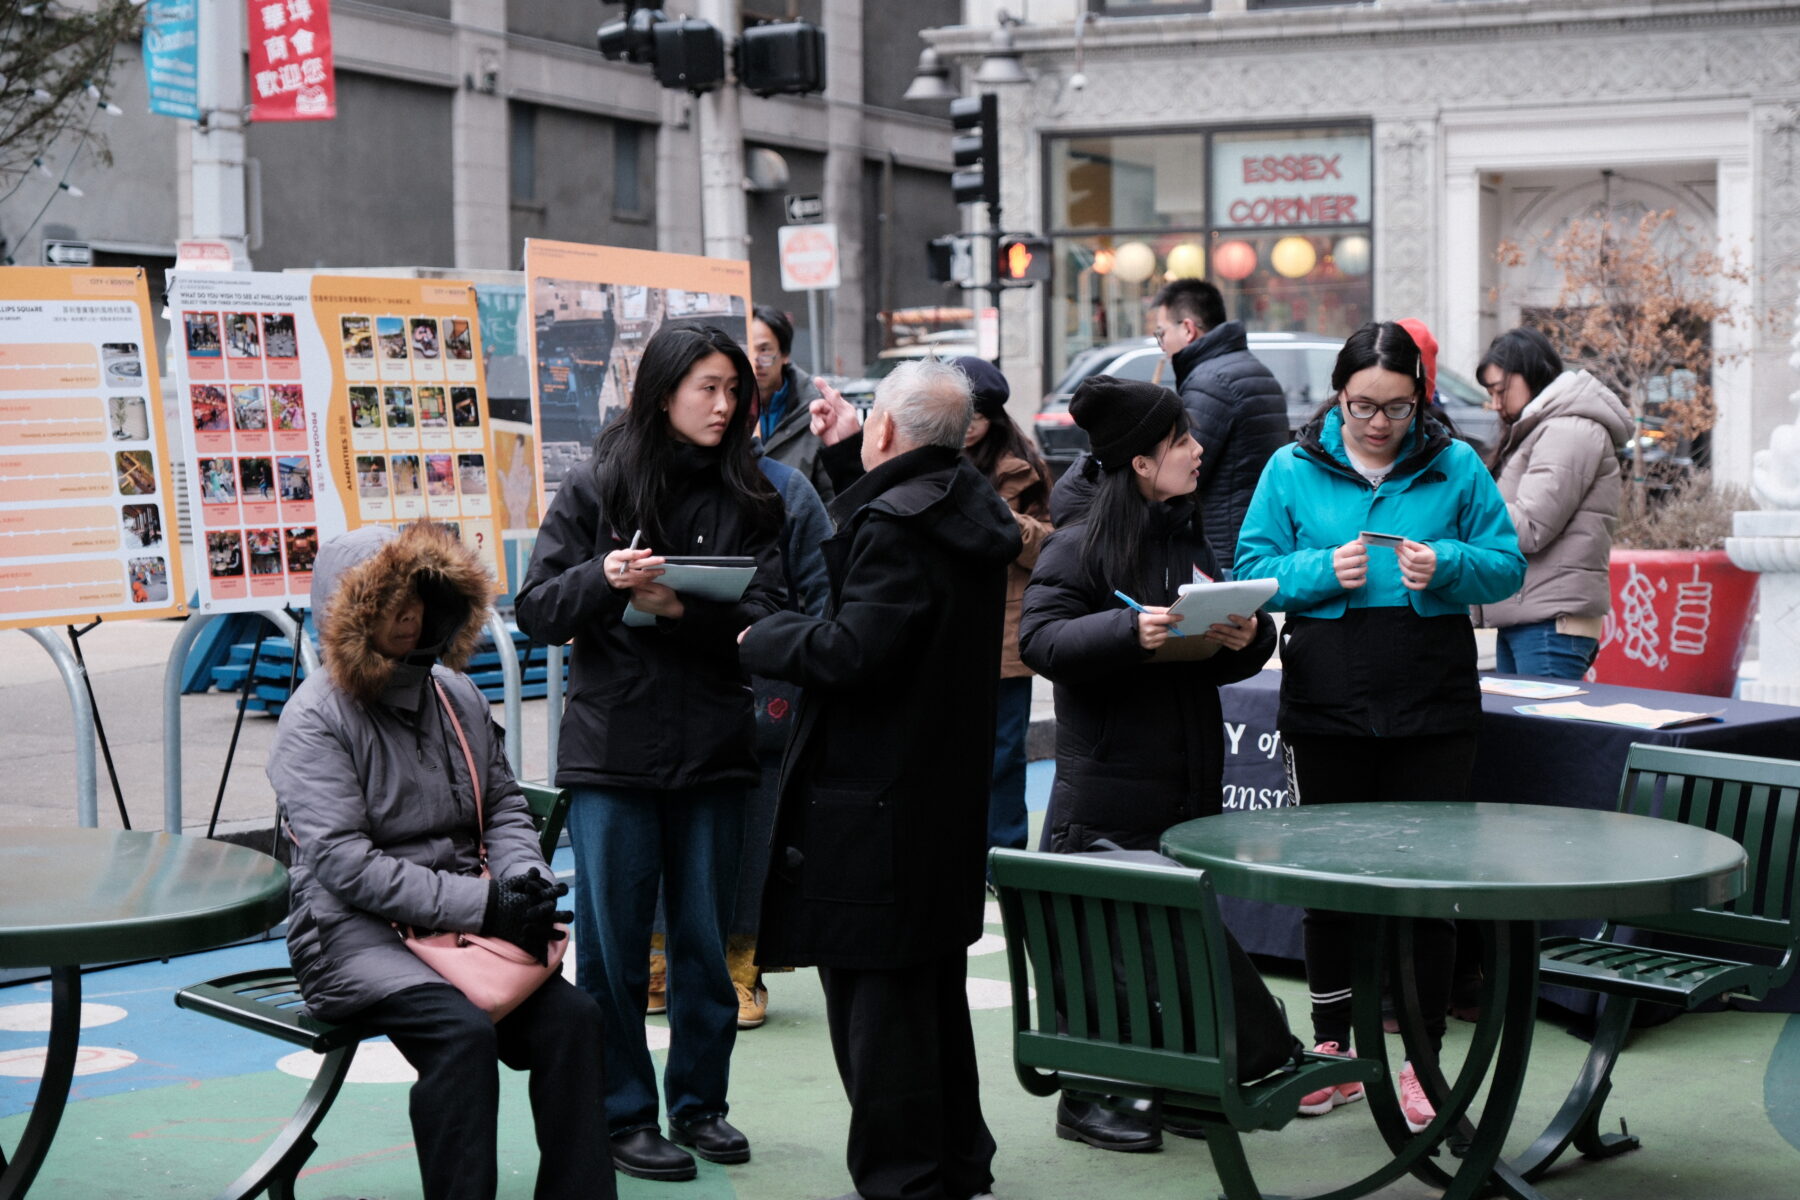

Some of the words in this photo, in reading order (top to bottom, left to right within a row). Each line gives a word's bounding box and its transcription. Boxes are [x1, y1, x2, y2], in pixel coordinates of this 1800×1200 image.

[1242, 153, 1342, 184] ESSEX
[1228, 194, 1358, 224] CORNER
[311, 412, 322, 469] PROGRAMS
[341, 438, 352, 491] AMENITIES
[1258, 730, 1281, 759] of
